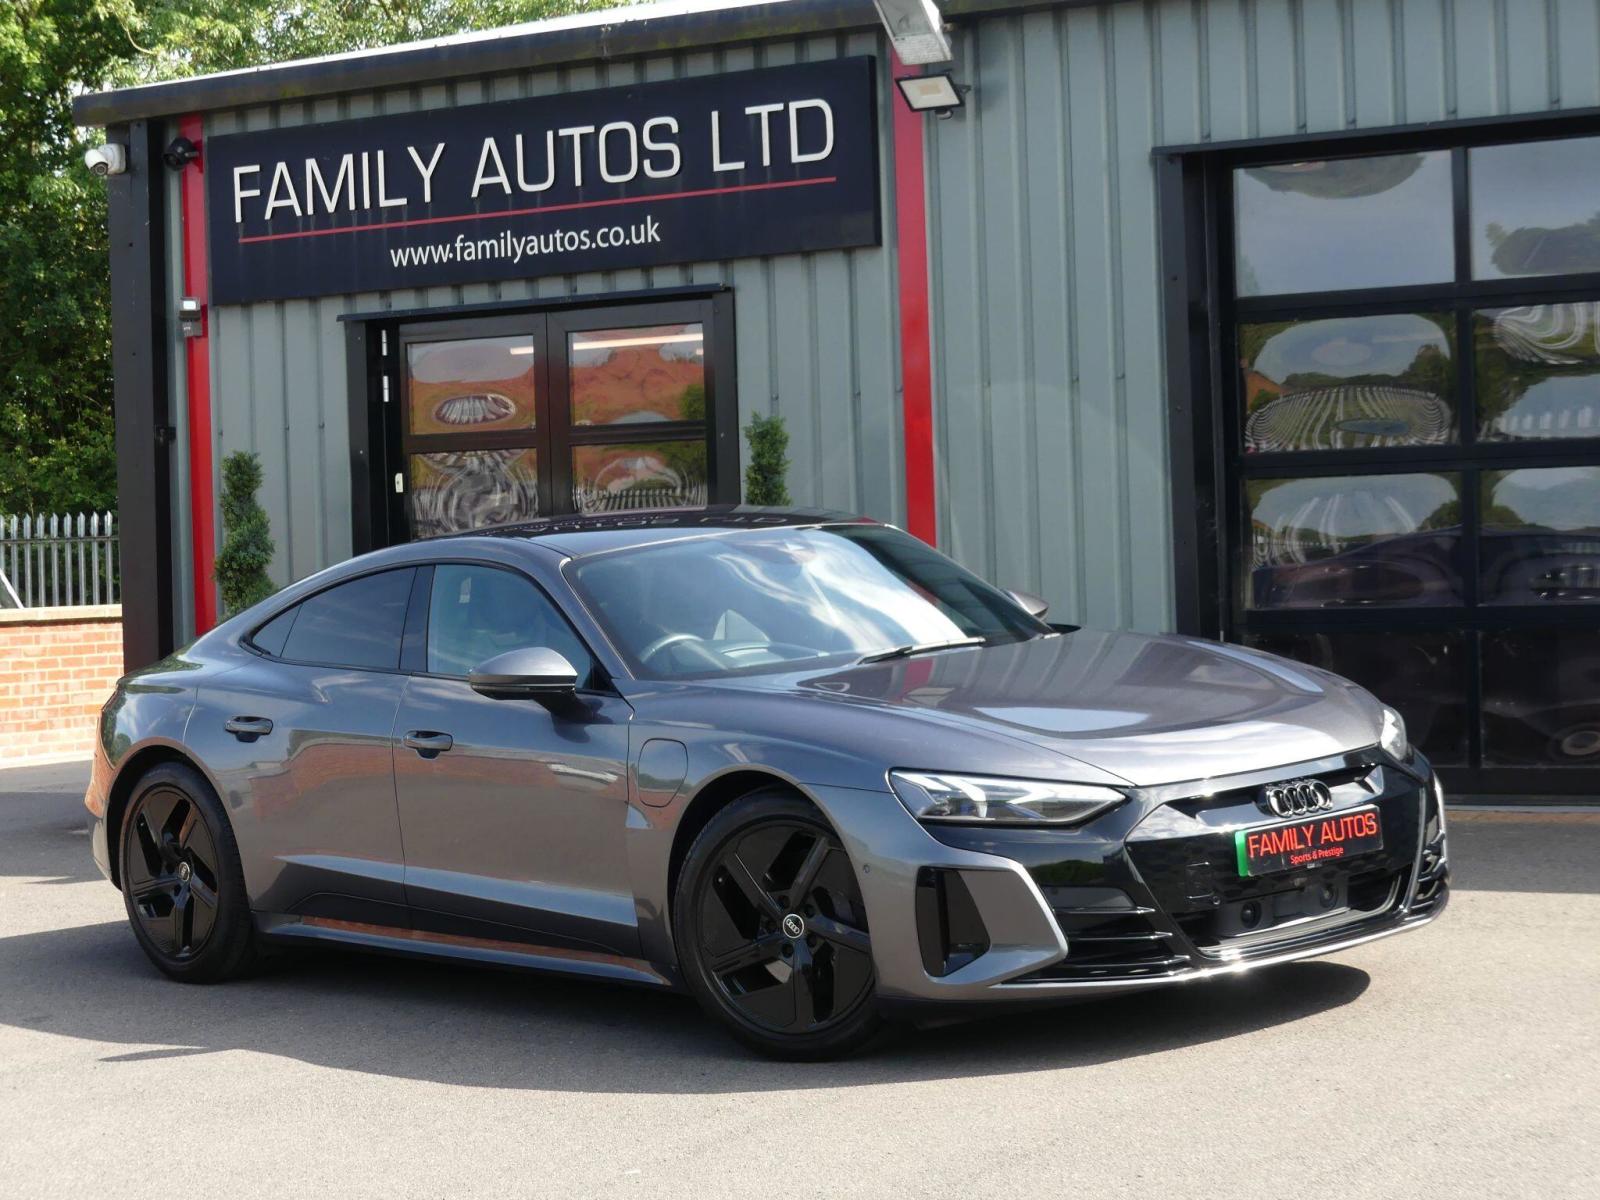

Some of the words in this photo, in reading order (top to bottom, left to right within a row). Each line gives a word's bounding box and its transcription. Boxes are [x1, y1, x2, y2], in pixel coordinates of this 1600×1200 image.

[234, 142, 446, 223] FAMILY
[471, 116, 681, 198] AUTOS
[711, 98, 834, 172] LTD
[390, 215, 661, 268] www.familyautos.co.uk
[1248, 824, 1314, 858] FAMILY
[1321, 813, 1377, 844] AUTOS
[1290, 853, 1311, 865] Sports
[1318, 846, 1344, 858] Prestige
